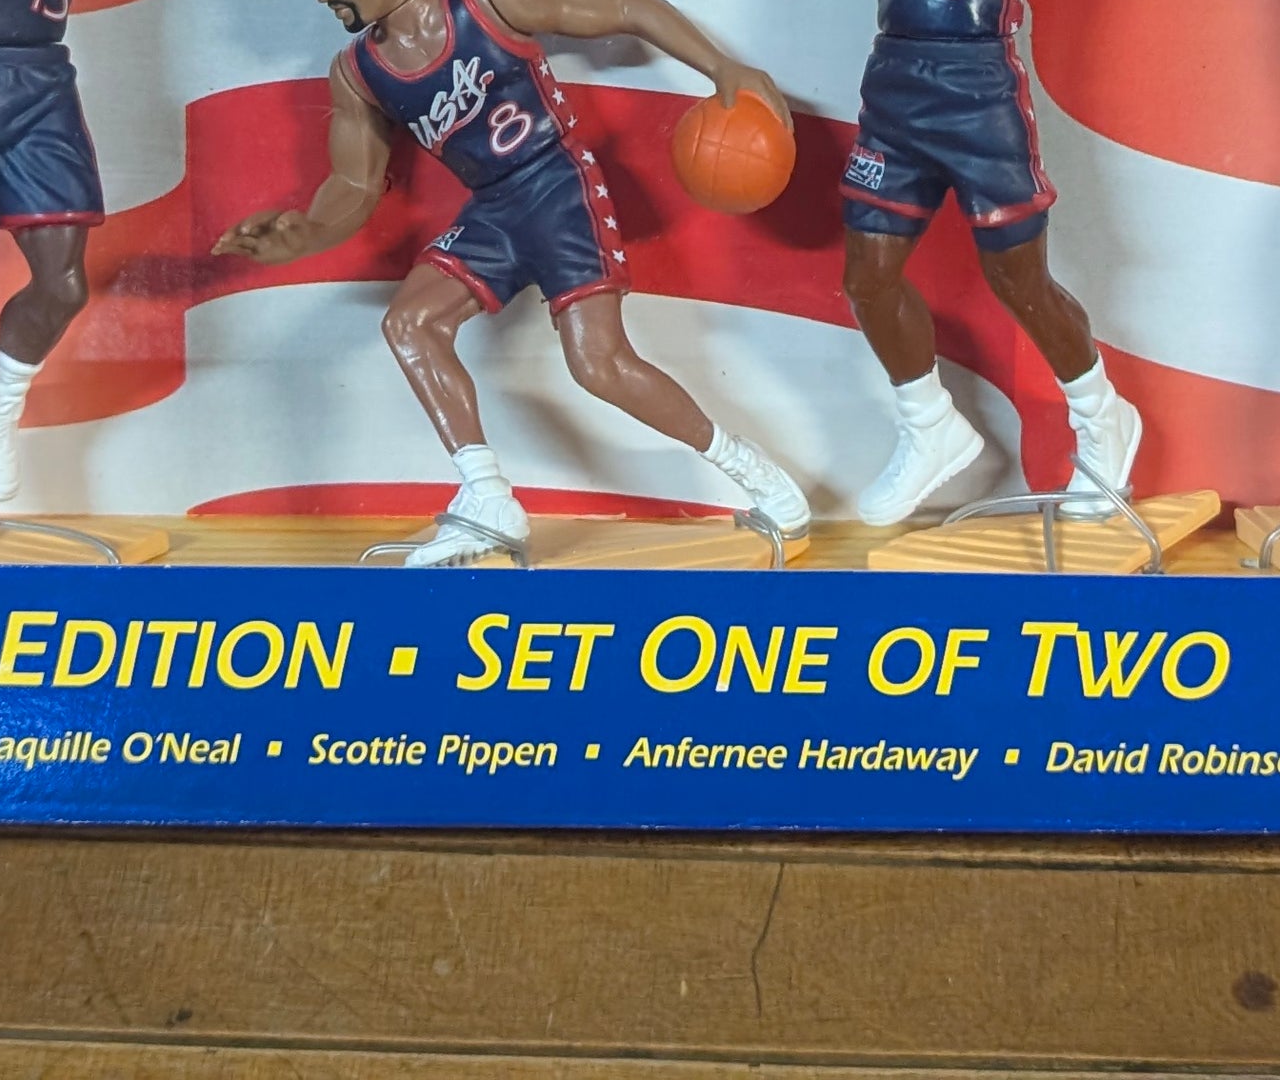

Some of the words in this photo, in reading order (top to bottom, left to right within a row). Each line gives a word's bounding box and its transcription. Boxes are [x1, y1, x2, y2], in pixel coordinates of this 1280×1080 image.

[408, 56, 492, 150] USA
[488, 100, 534, 156] 8
[455, 612, 615, 693] SET
[639, 614, 838, 695] ONE
[866, 627, 989, 697] OF
[1018, 621, 1231, 701] TWO
[121, 731, 241, 764] O'Neal
[308, 733, 426, 765] Scottie
[437, 734, 558, 775] Pippen
[623, 736, 788, 769] Anfernee
[798, 739, 979, 781] Hardaway
[1046, 741, 1149, 773] David
